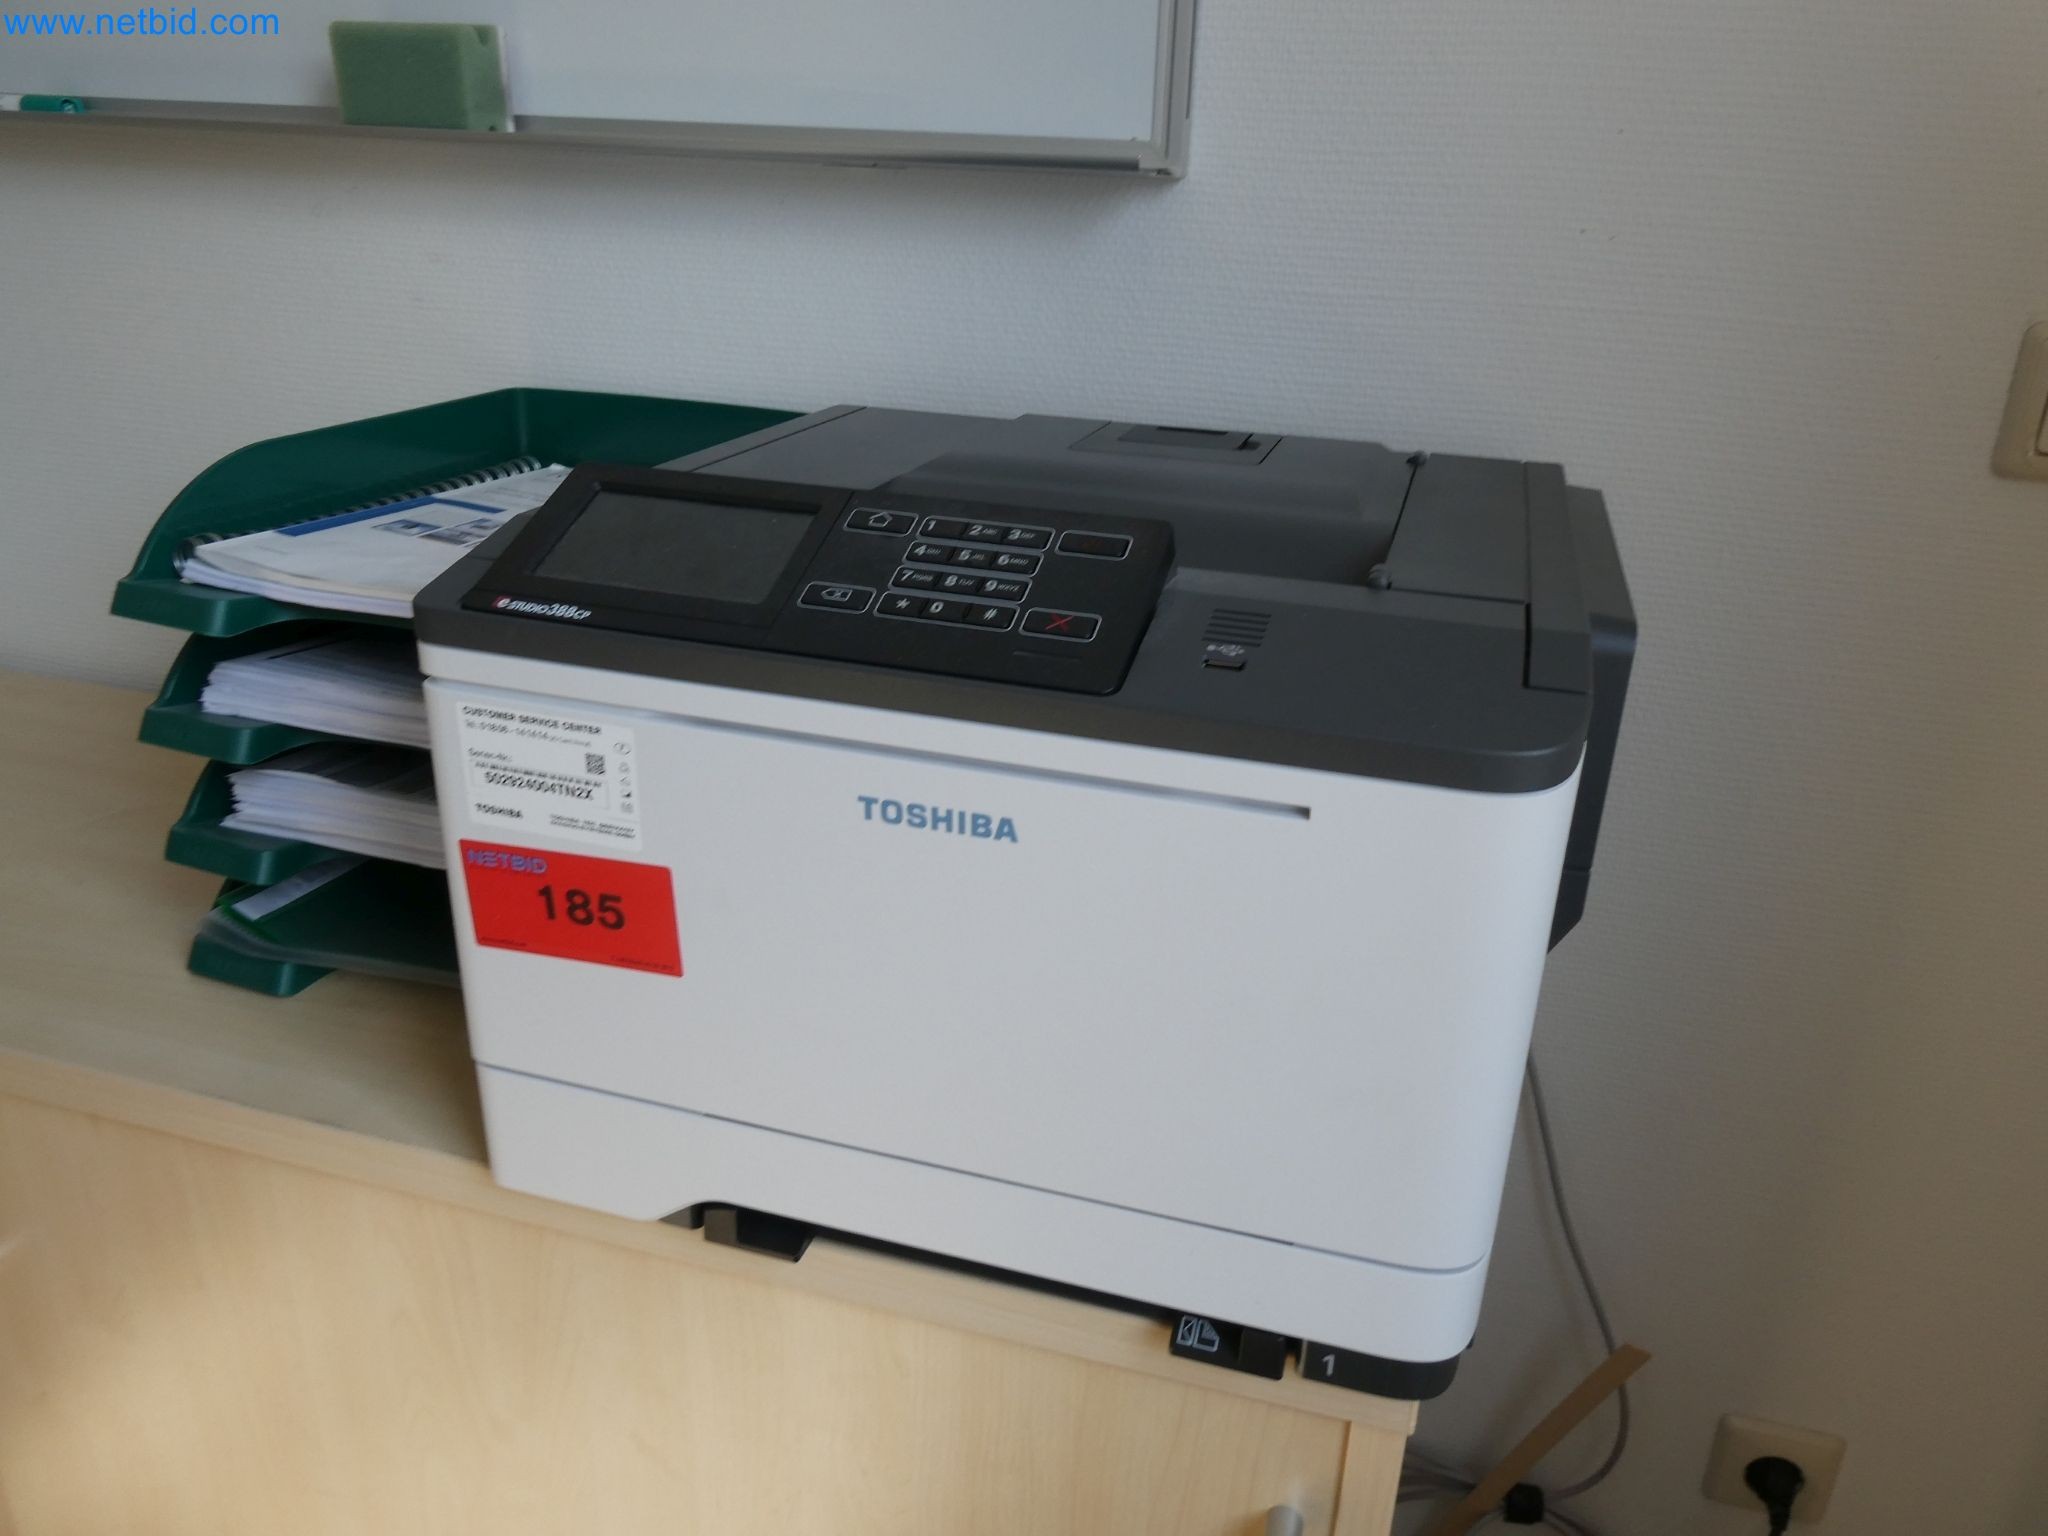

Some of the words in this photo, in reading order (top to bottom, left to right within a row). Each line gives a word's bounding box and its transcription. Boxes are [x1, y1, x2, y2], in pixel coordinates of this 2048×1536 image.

[927, 519, 937, 531] 1
[968, 524, 983, 536] 2
[1008, 528, 1022, 540] 3
[914, 544, 927, 556] 4
[958, 549, 972, 561] 5
[997, 553, 1010, 566] 6
[900, 569, 914, 582] 7
[944, 574, 958, 587] 8
[985, 579, 998, 592] 9
[929, 601, 944, 614] 0
[462, 704, 516, 722] CUSTOMER
[517, 714, 560, 730] SERVICE
[561, 720, 602, 736] CENTER
[474, 801, 524, 819] TOSHIBA
[857, 795, 1019, 844] TOSHIBA
[466, 850, 548, 874] NETBID
[537, 884, 626, 931] 185
[1321, 1353, 1336, 1378] 1
